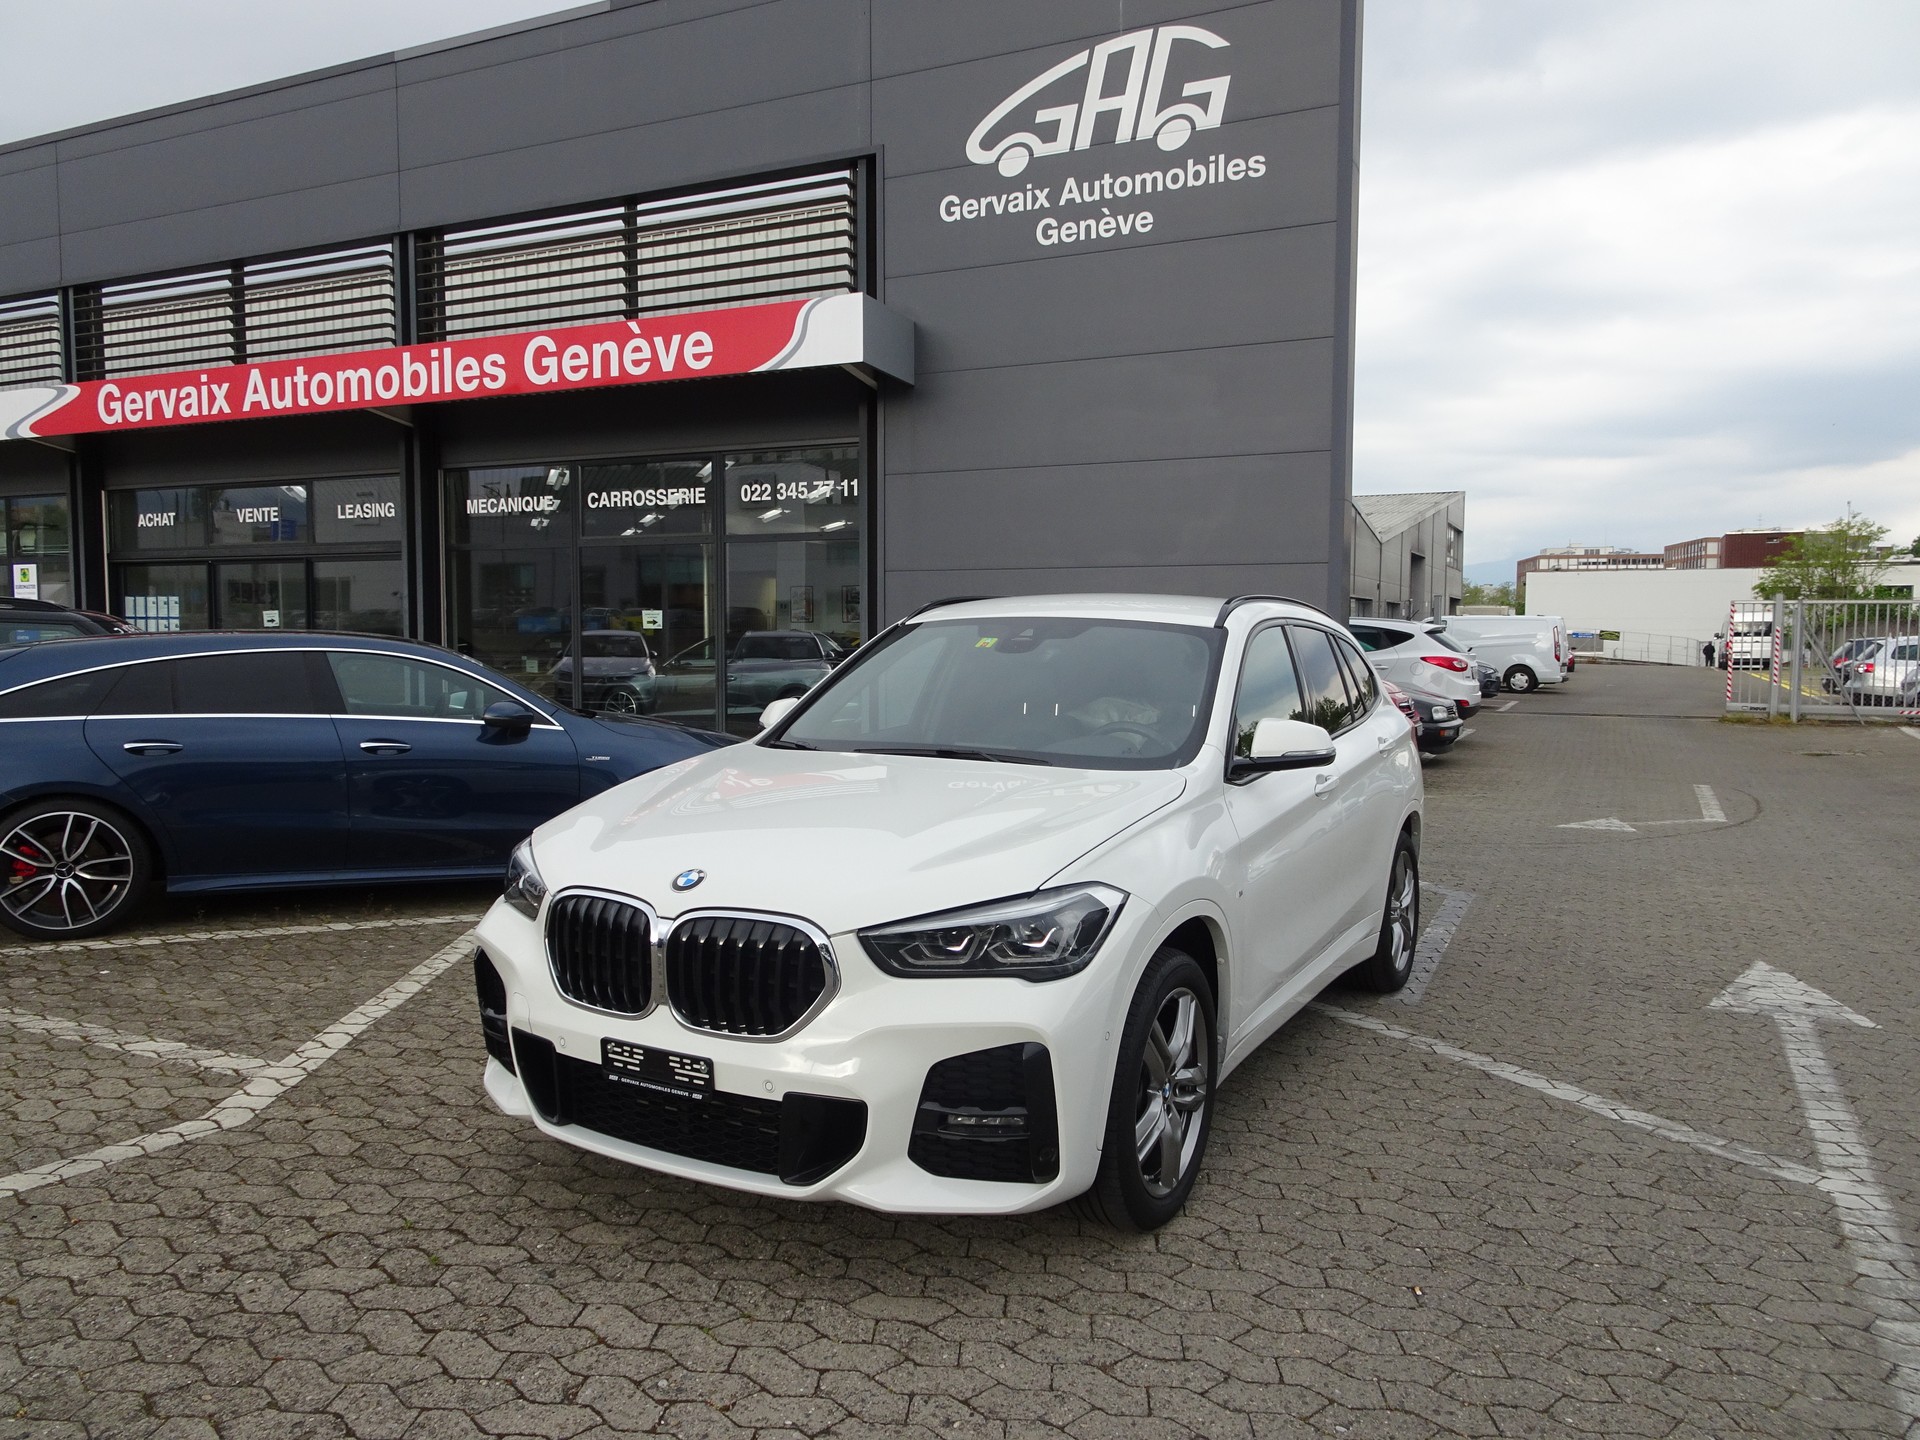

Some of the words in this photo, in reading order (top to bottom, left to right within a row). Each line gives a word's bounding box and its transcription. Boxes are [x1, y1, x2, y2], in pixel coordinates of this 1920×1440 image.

[939, 184, 1050, 223] Gervaix
[1059, 154, 1267, 206] Automobiles
[1036, 208, 1154, 246] Genève
[98, 374, 232, 425] Gervaix
[243, 346, 507, 412] Automobiles
[523, 321, 714, 385] Genève
[587, 487, 706, 509] CARROSSERIE
[740, 483, 772, 502] 022
[776, 482, 808, 500] 345
[813, 480, 835, 498] 77
[840, 478, 858, 497] 11
[236, 506, 279, 523] VENTE
[337, 502, 396, 519] LEASING
[466, 495, 554, 514] MECANIQUE
[137, 512, 176, 528] ACHAT
[640, 1082, 670, 1093] AUTOMOBILES
